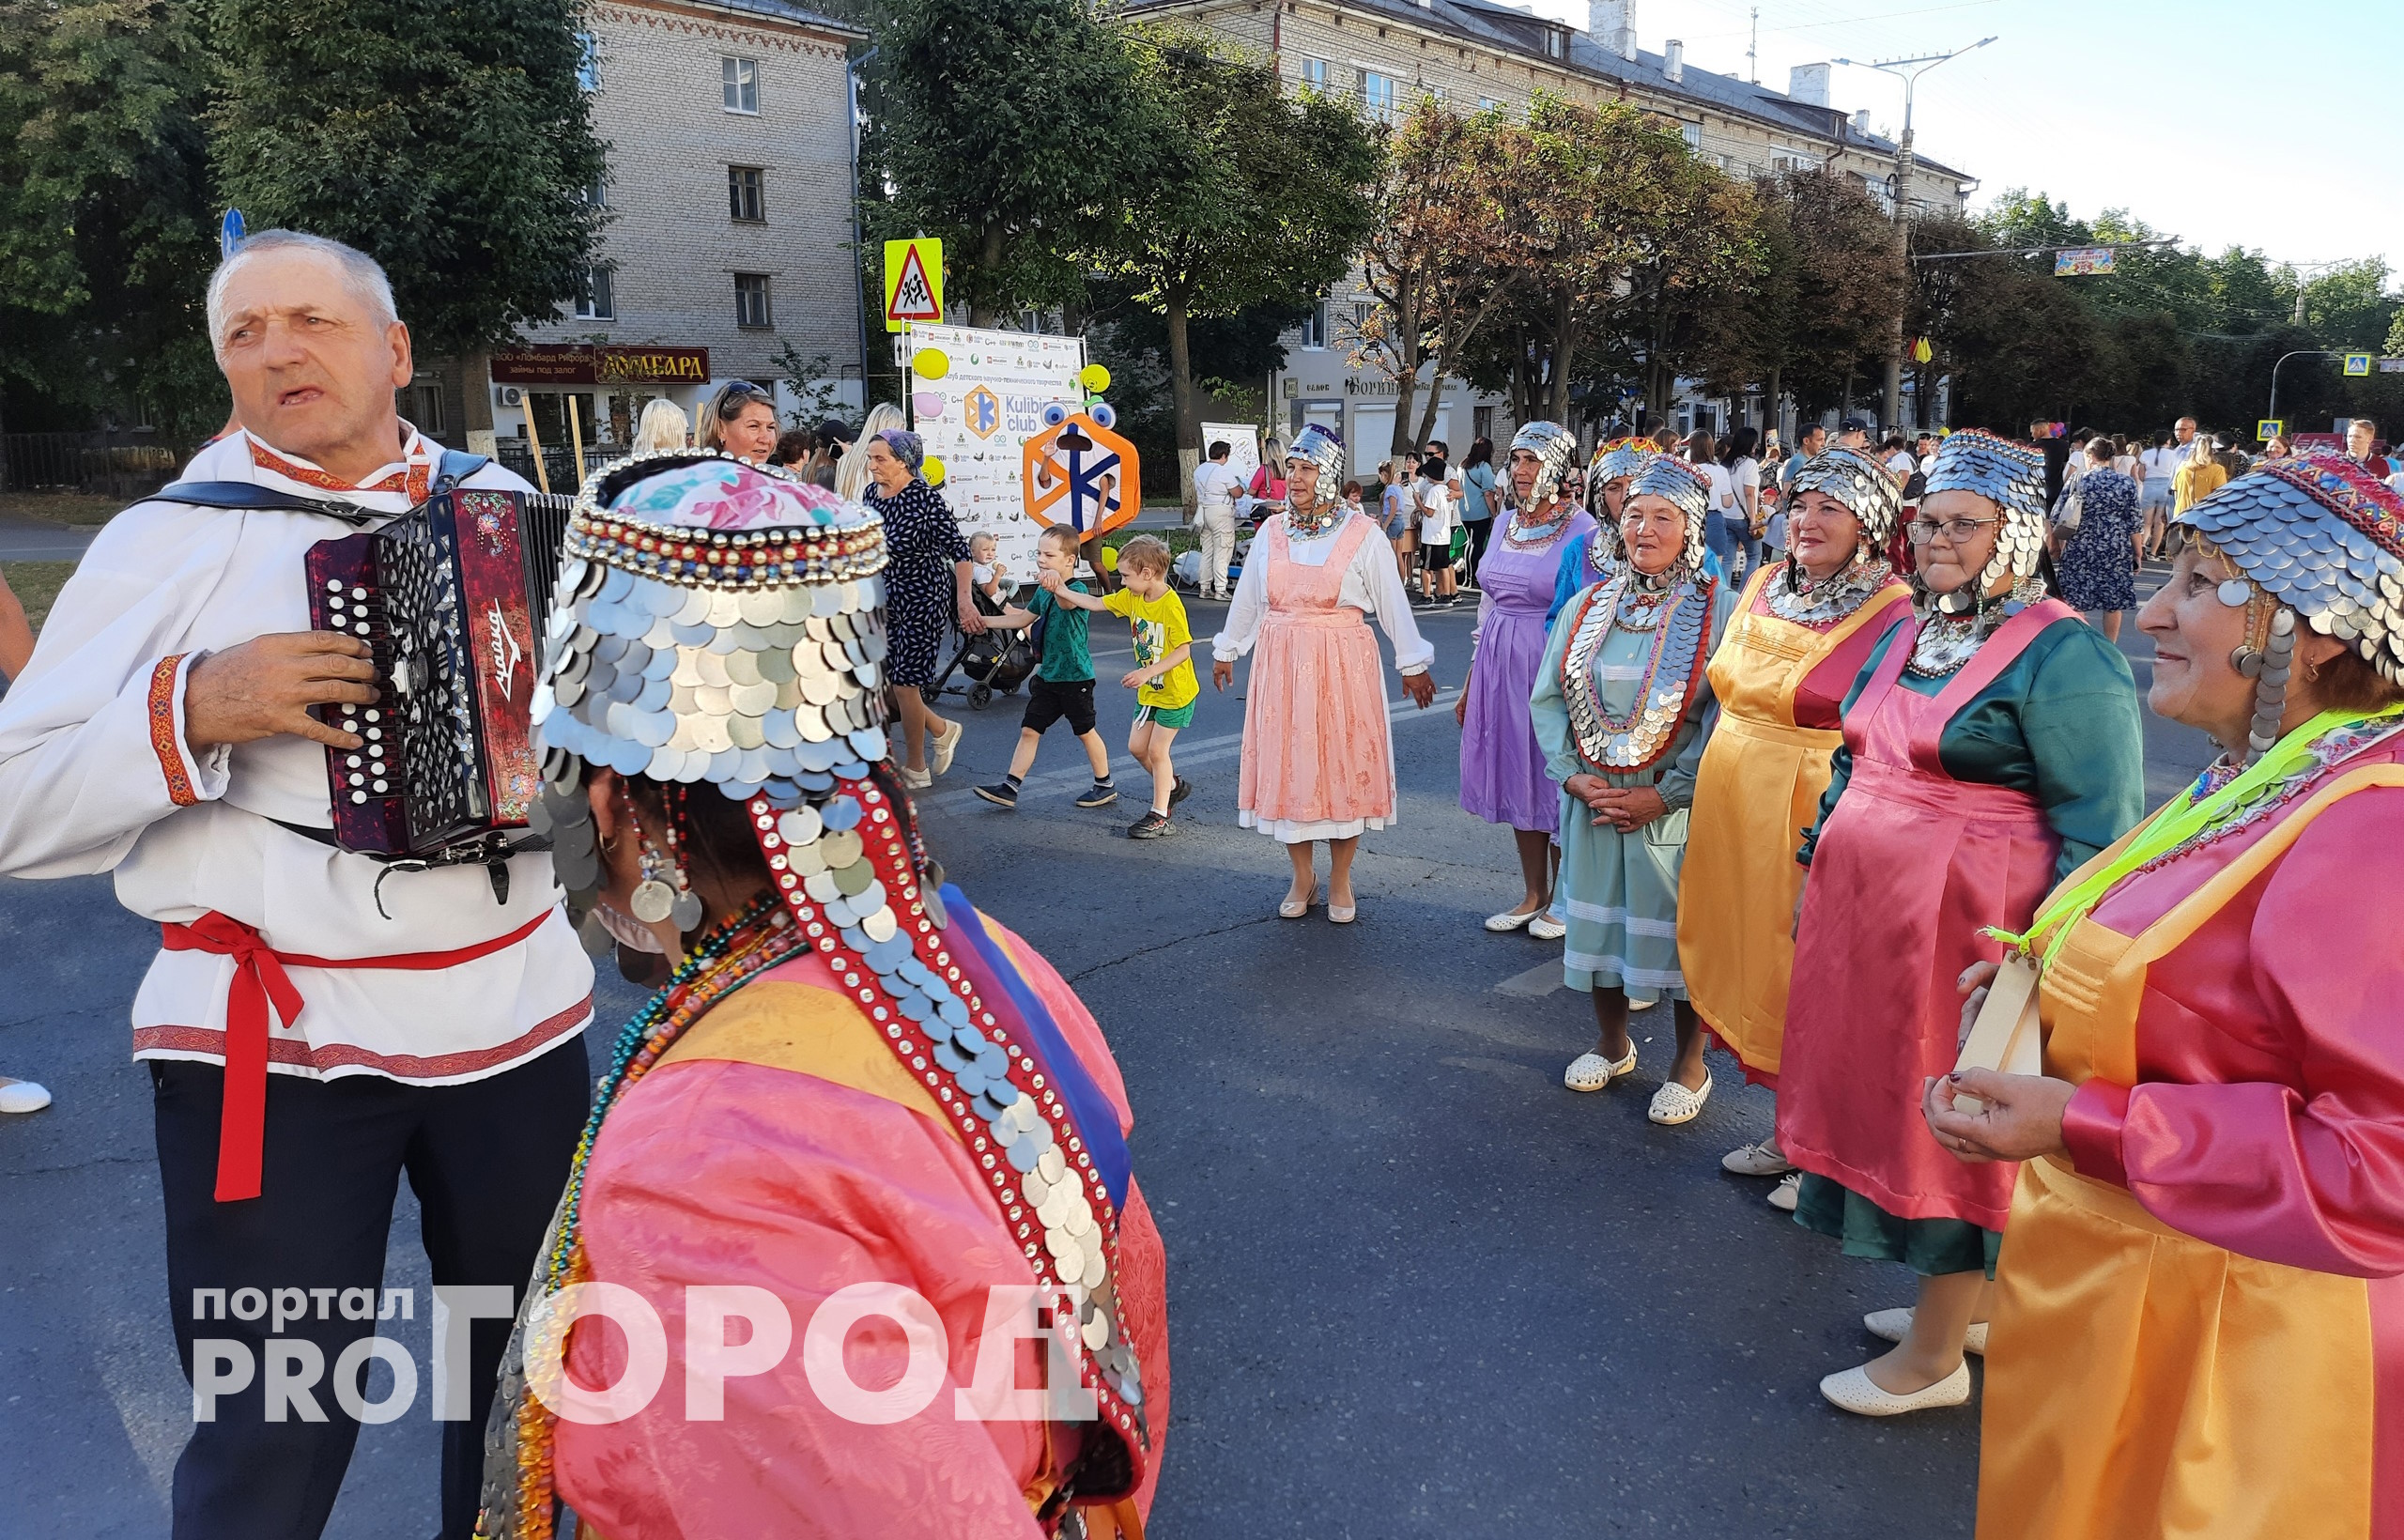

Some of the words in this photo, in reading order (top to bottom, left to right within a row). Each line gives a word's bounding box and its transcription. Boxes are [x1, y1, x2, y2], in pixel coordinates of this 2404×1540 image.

[510, 365, 534, 374] займы
[536, 366, 552, 375] под
[554, 366, 577, 375] залог
[950, 395, 963, 404] C++
[1008, 414, 1037, 432] club
[487, 599, 516, 701] Чайка
